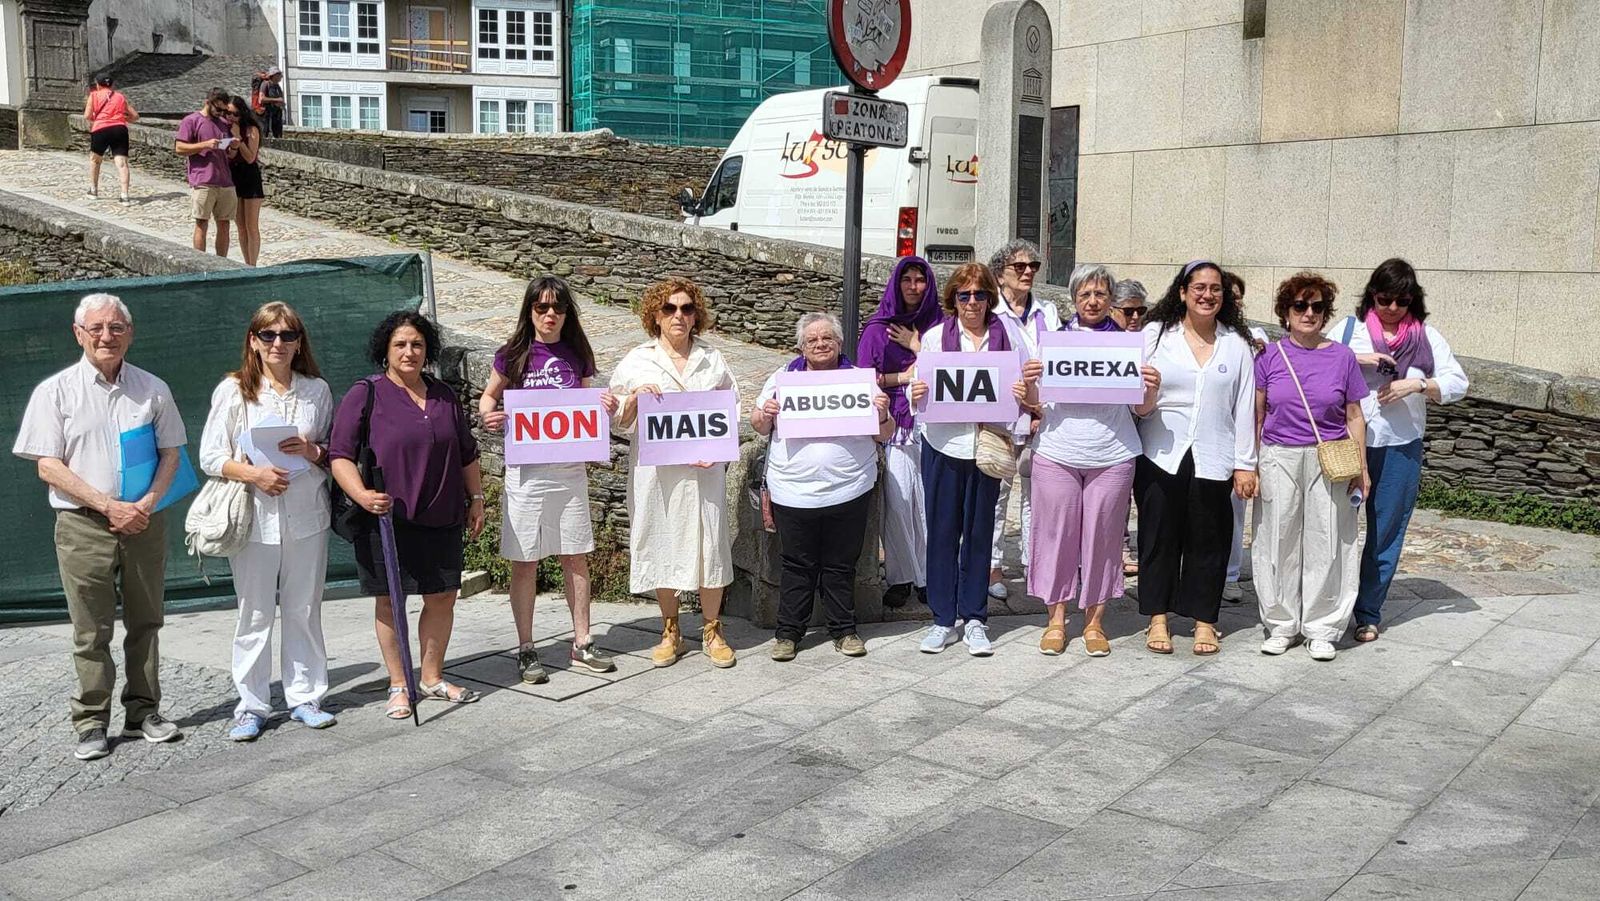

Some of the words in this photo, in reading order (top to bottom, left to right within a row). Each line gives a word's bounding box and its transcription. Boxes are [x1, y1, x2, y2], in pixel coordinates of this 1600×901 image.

[853, 102, 888, 120] ZONA
[936, 227, 959, 235] IVECO
[933, 251, 953, 261] 4615
[1047, 360, 1139, 377] IGREXA
[935, 368, 998, 403] NA
[781, 393, 872, 413] ABUSOS
[514, 410, 598, 441] NON
[648, 413, 728, 440] MAIS
